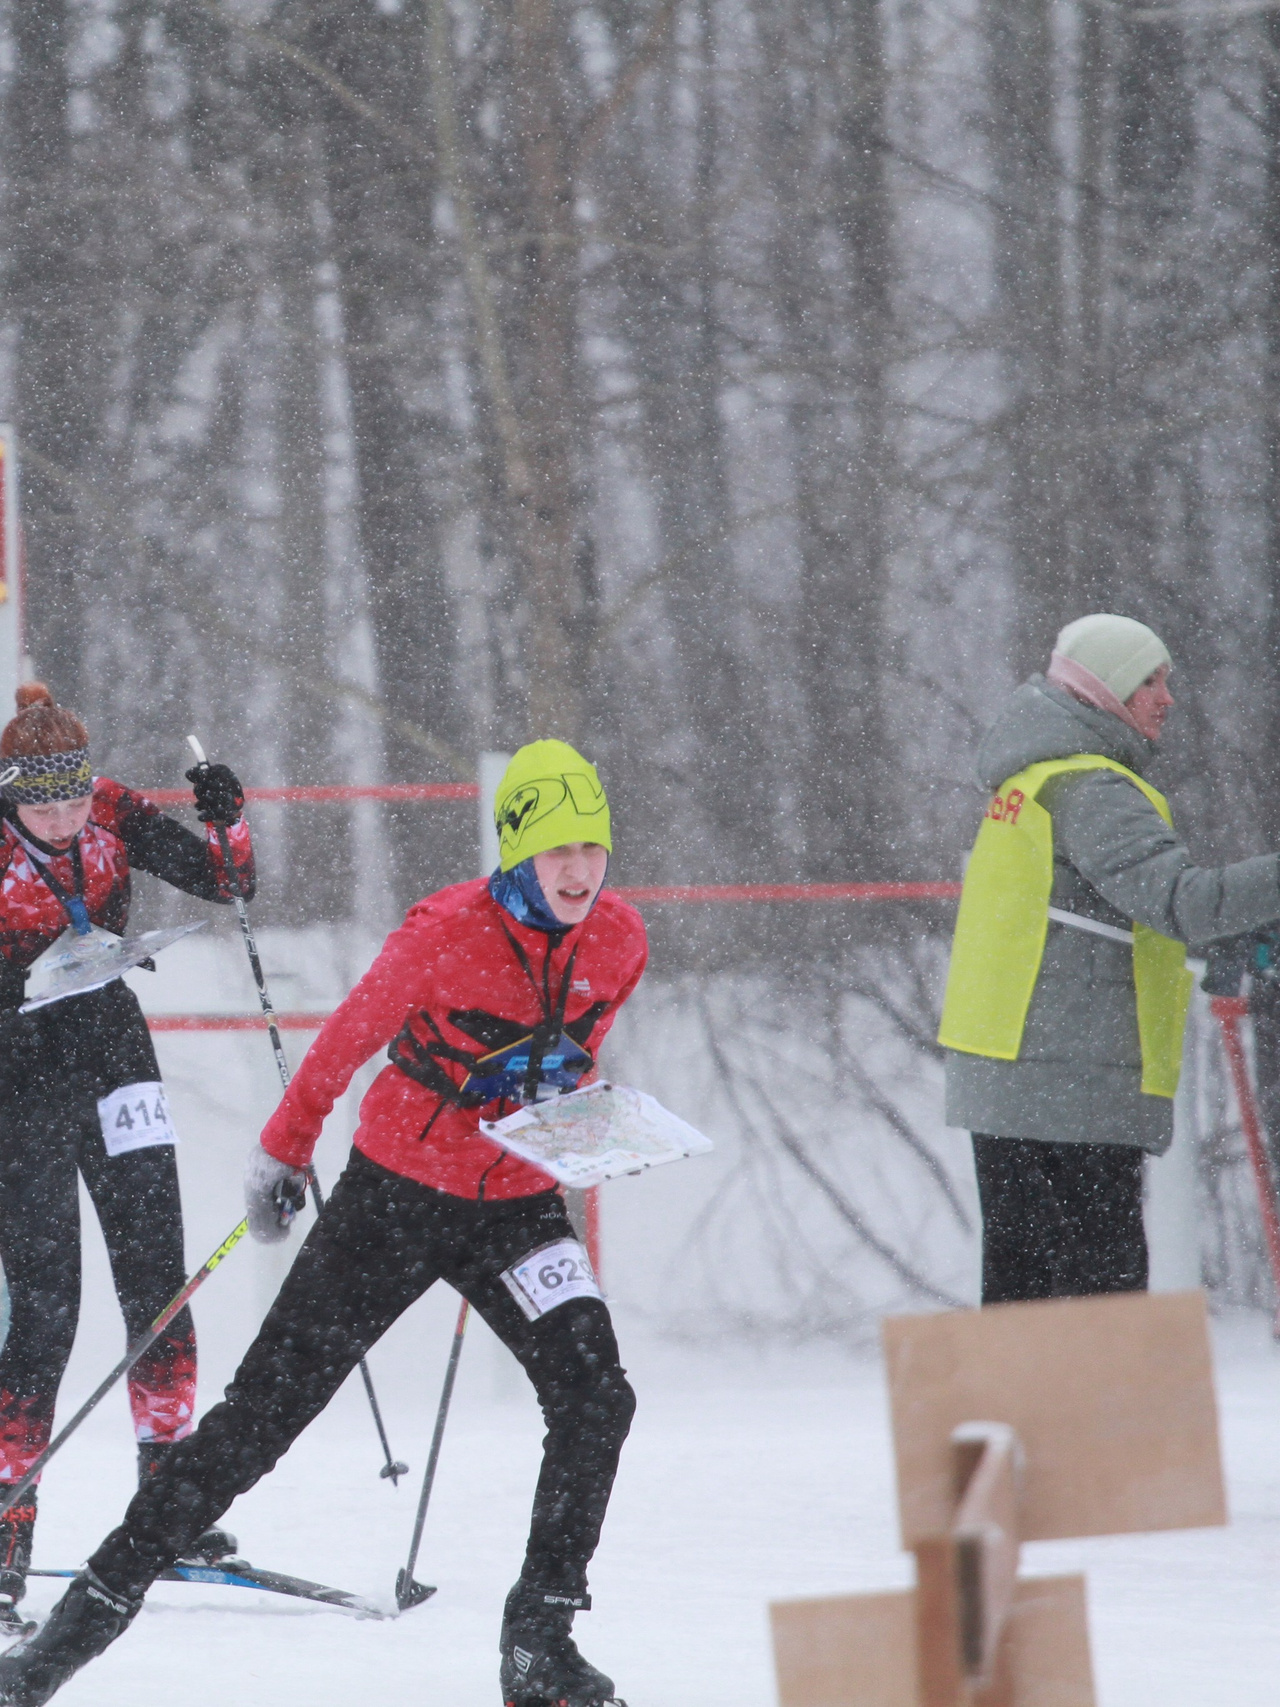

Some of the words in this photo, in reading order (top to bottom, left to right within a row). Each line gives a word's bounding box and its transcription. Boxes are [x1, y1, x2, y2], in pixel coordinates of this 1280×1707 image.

[274, 1048, 291, 1089] SPOR
[115, 1098, 167, 1130] 414
[86, 1586, 129, 1615] SPINE
[544, 1595, 583, 1607] SPINE
